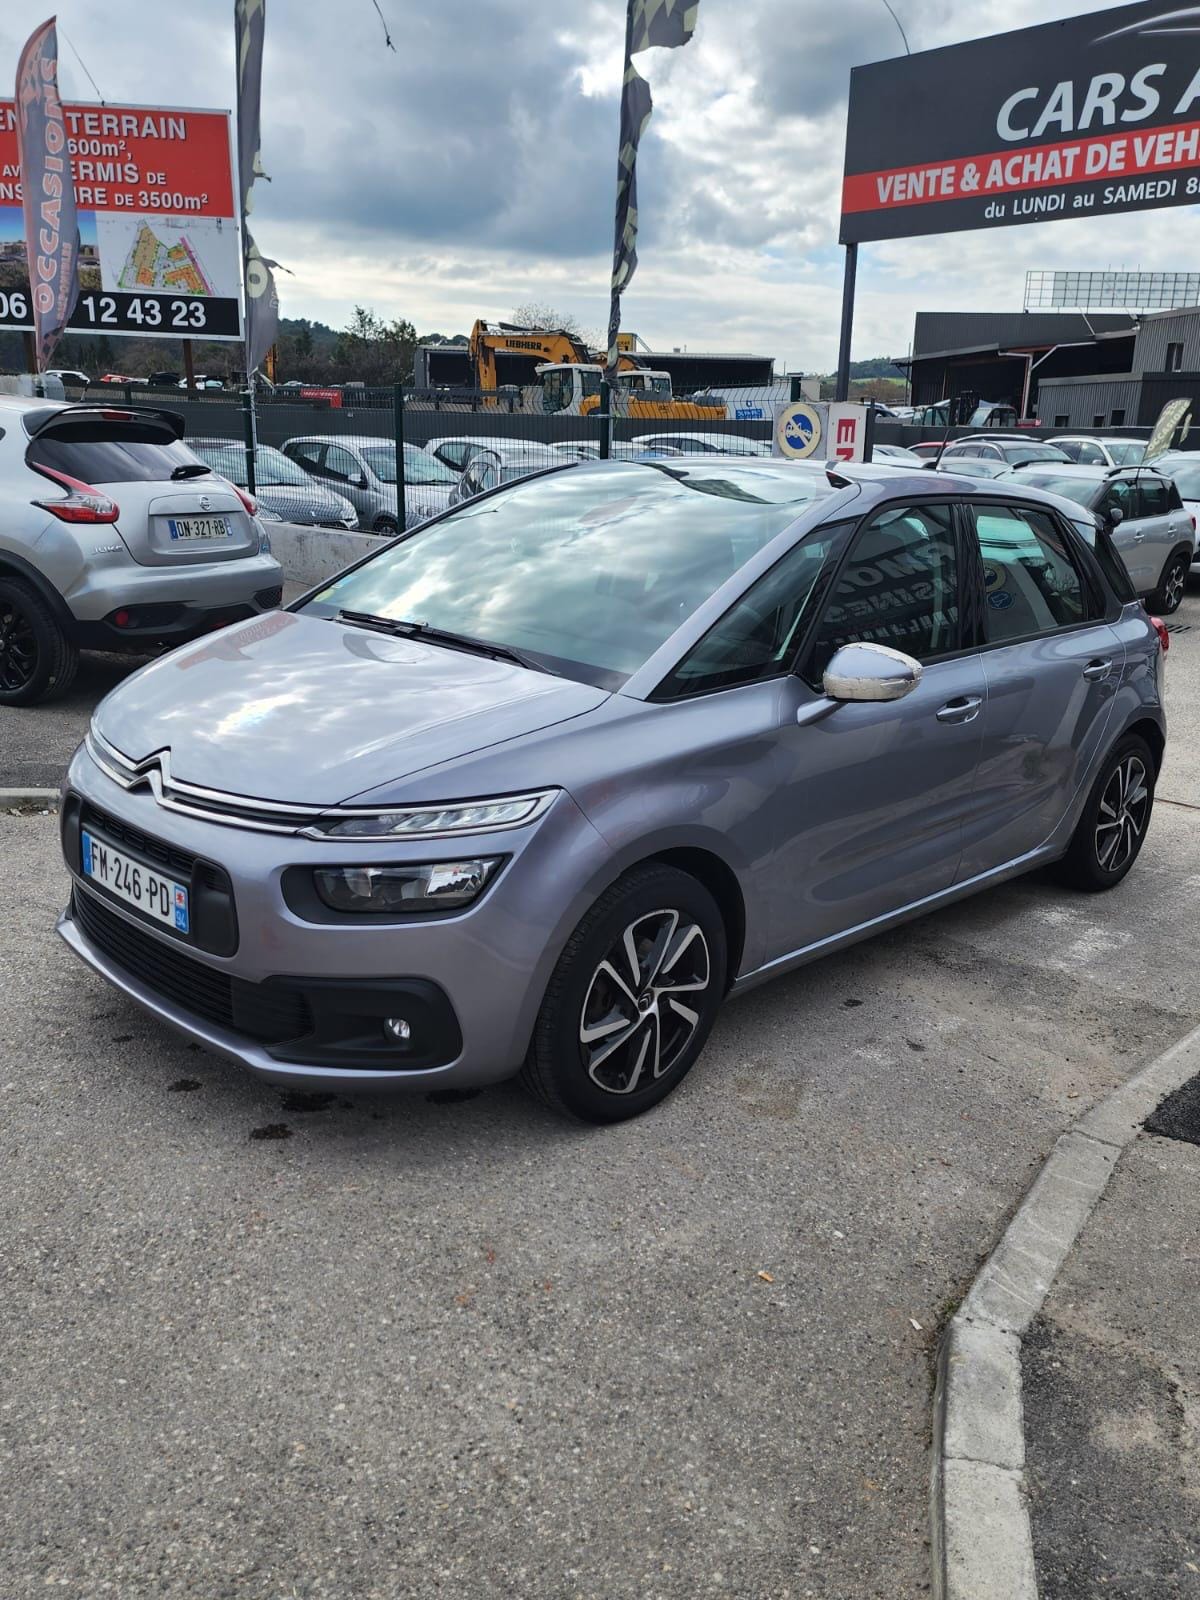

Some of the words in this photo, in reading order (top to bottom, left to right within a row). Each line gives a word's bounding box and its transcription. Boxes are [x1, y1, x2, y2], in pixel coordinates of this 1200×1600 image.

[996, 63, 1167, 142] CARS
[66, 111, 186, 140] TERRAIN
[147, 172, 167, 185] DE
[876, 166, 957, 203] VENTE
[960, 163, 981, 192] &
[985, 147, 1081, 189] ACHAT
[1085, 139, 1127, 175] DE
[1134, 128, 1200, 168] VEH
[34, 57, 65, 314] OCCASIONS
[114, 193, 135, 206] DE
[985, 201, 1005, 219] du
[1013, 193, 1066, 216] LUNDI
[1073, 190, 1094, 208] au
[1102, 179, 1176, 205] SAMEDI
[1186, 177, 1200, 195] 8
[82, 296, 119, 324] 12
[127, 298, 162, 326] 43
[171, 300, 206, 328] 23
[505, 339, 542, 351] LIEBHERR
[90, 842, 170, 917] FM-246-PD
